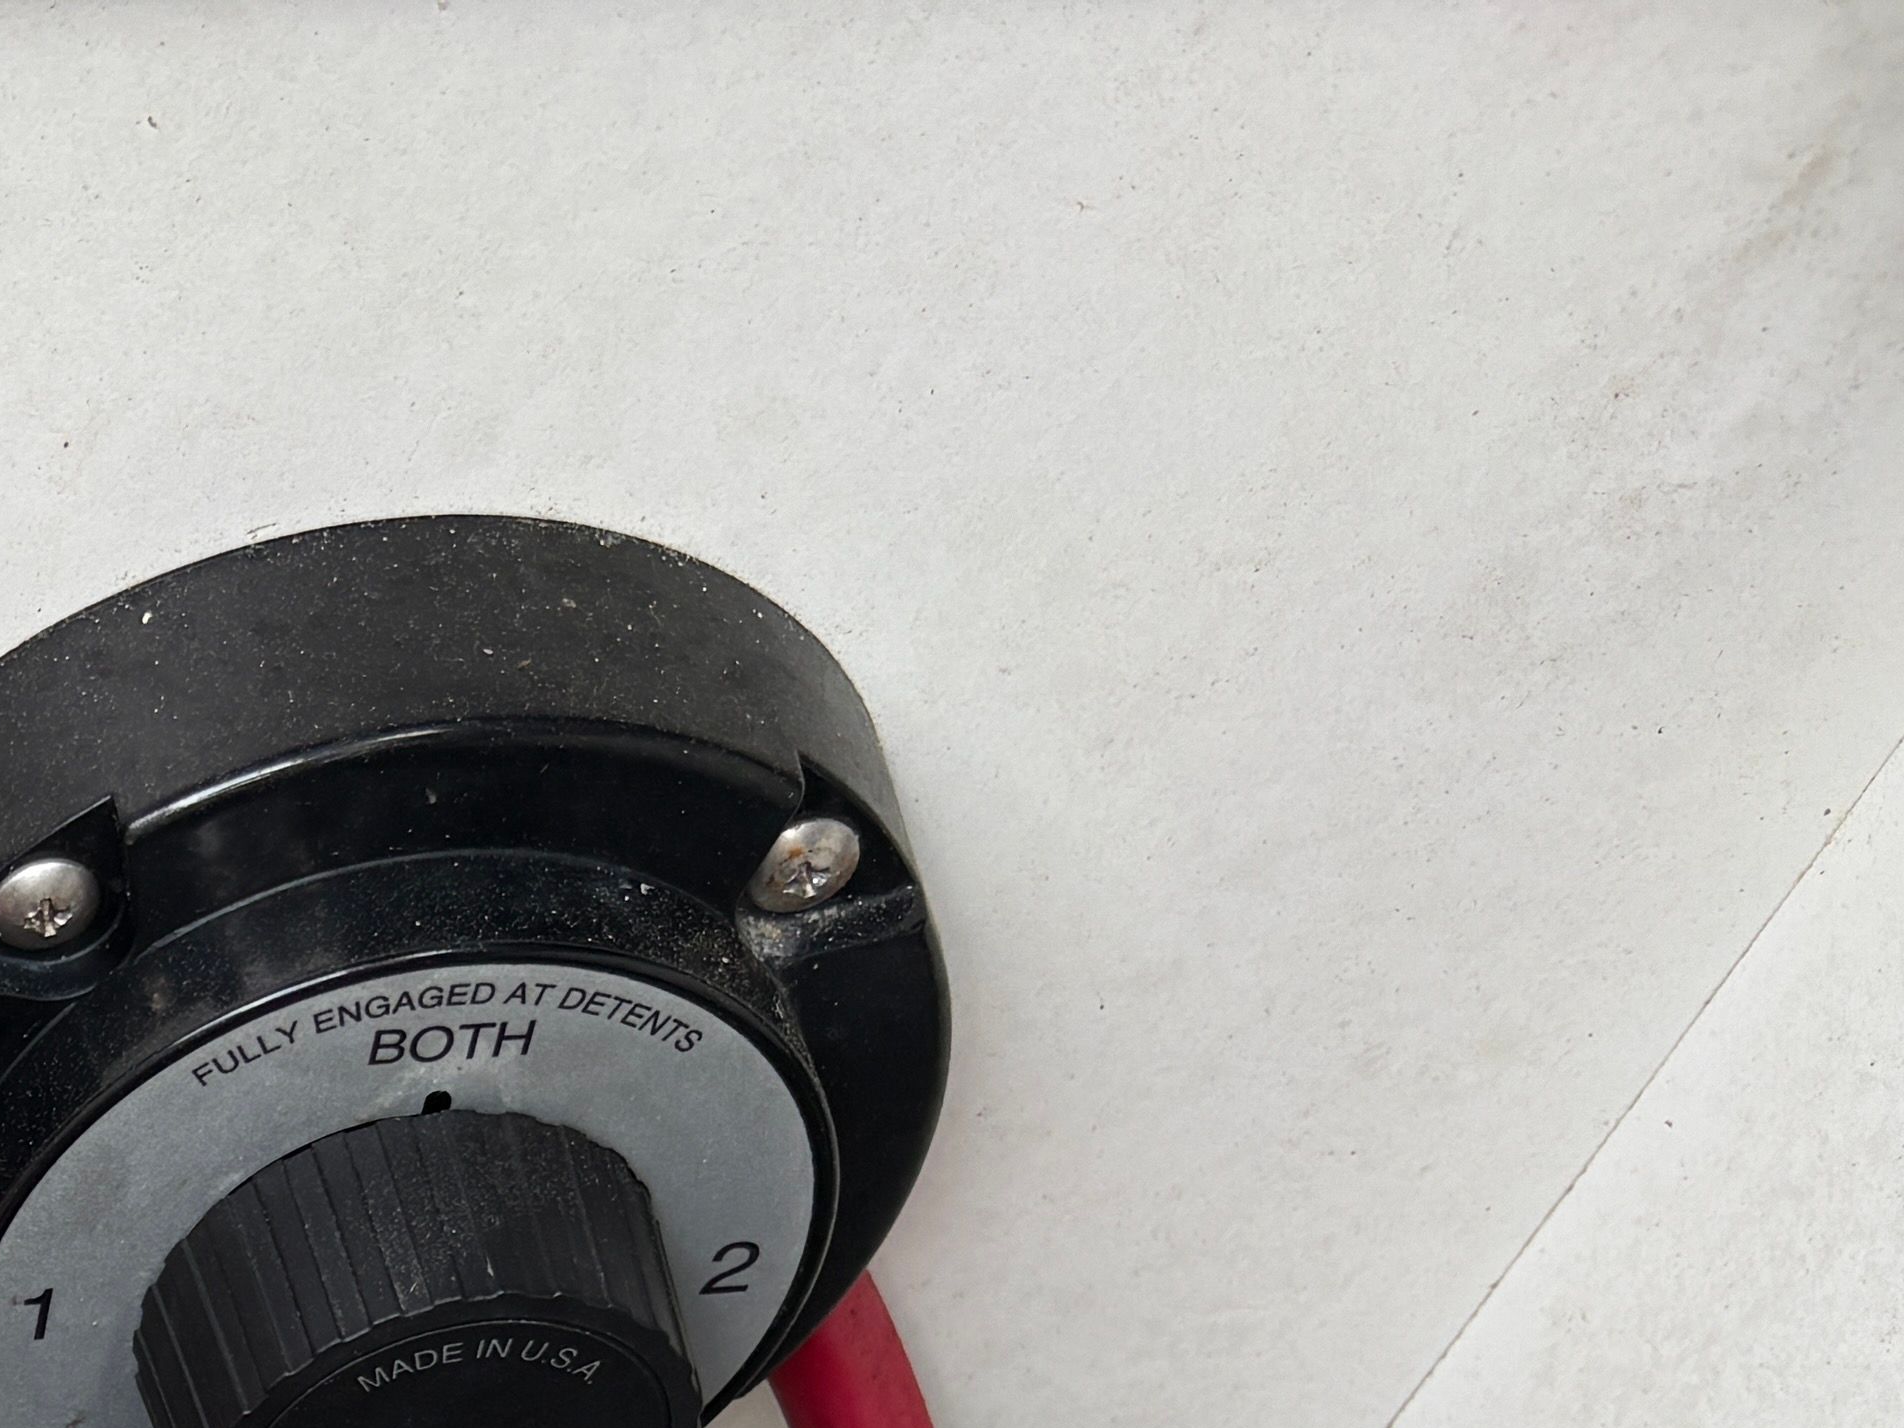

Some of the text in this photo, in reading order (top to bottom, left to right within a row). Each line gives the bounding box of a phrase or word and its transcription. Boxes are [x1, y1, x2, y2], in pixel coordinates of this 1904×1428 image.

[193, 980, 704, 1087] FULLY ENGAGED AT DETENTS
[367, 1019, 536, 1068] BOTH
[700, 1242, 762, 1295] 2
[24, 1288, 55, 1341] 1
[355, 1343, 467, 1396] MADE
[476, 1338, 509, 1362] IN
